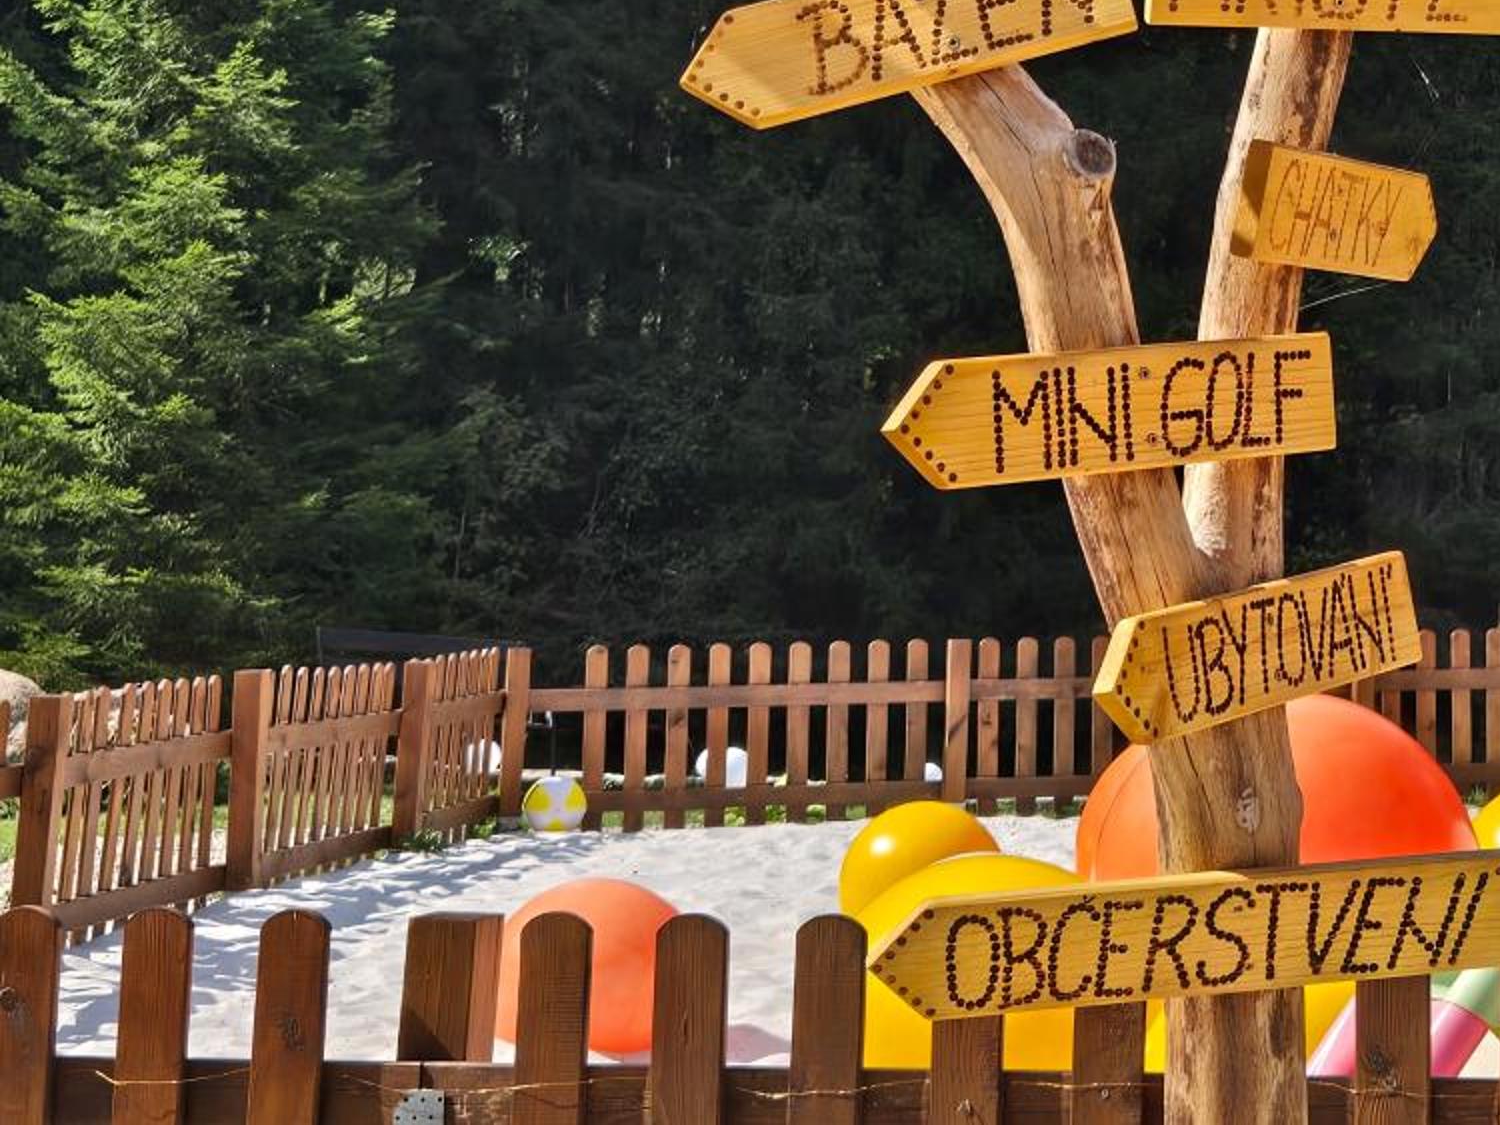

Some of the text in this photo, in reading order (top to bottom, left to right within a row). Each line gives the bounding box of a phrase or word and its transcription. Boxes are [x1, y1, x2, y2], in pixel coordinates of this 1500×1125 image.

[1270, 159, 1405, 268] CHATKY
[992, 350, 1311, 473] MINI GOLF
[1161, 563, 1397, 723] UBYTOVÁNÍ
